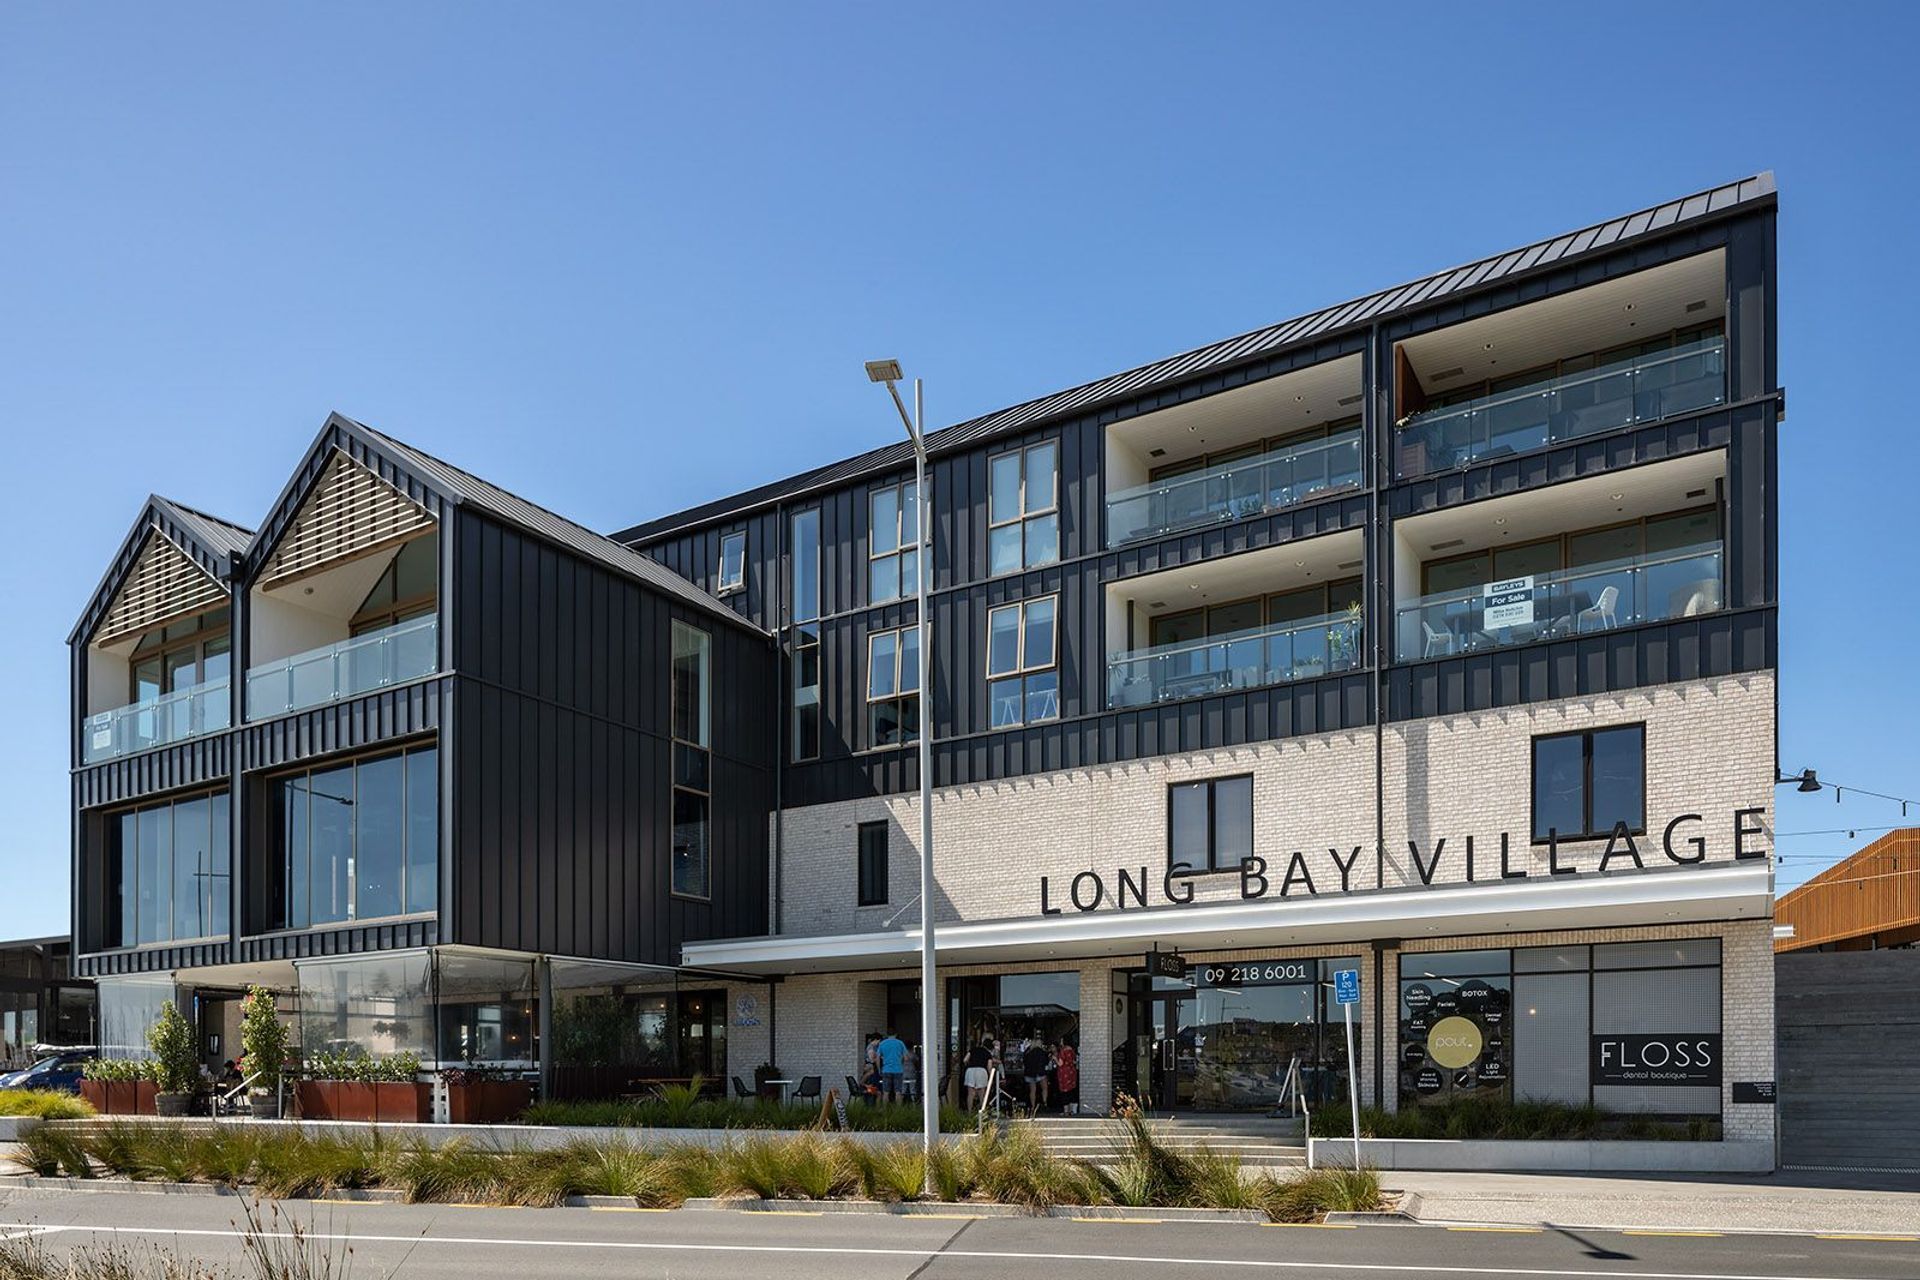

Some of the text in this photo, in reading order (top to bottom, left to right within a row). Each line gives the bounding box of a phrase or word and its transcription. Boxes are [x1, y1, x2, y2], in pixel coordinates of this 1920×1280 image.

[1492, 593, 1525, 605] For Sale
[1041, 807, 1766, 915] LONG BAY VILLAGE
[1161, 957, 1179, 973] FLOSS
[1204, 965, 1306, 982] 09 218 6001
[1342, 972, 1350, 981] P
[1462, 990, 1488, 998] BOTOX
[1601, 1041, 1711, 1068] FLOSS
[1623, 1071, 1687, 1080] dental boutique
